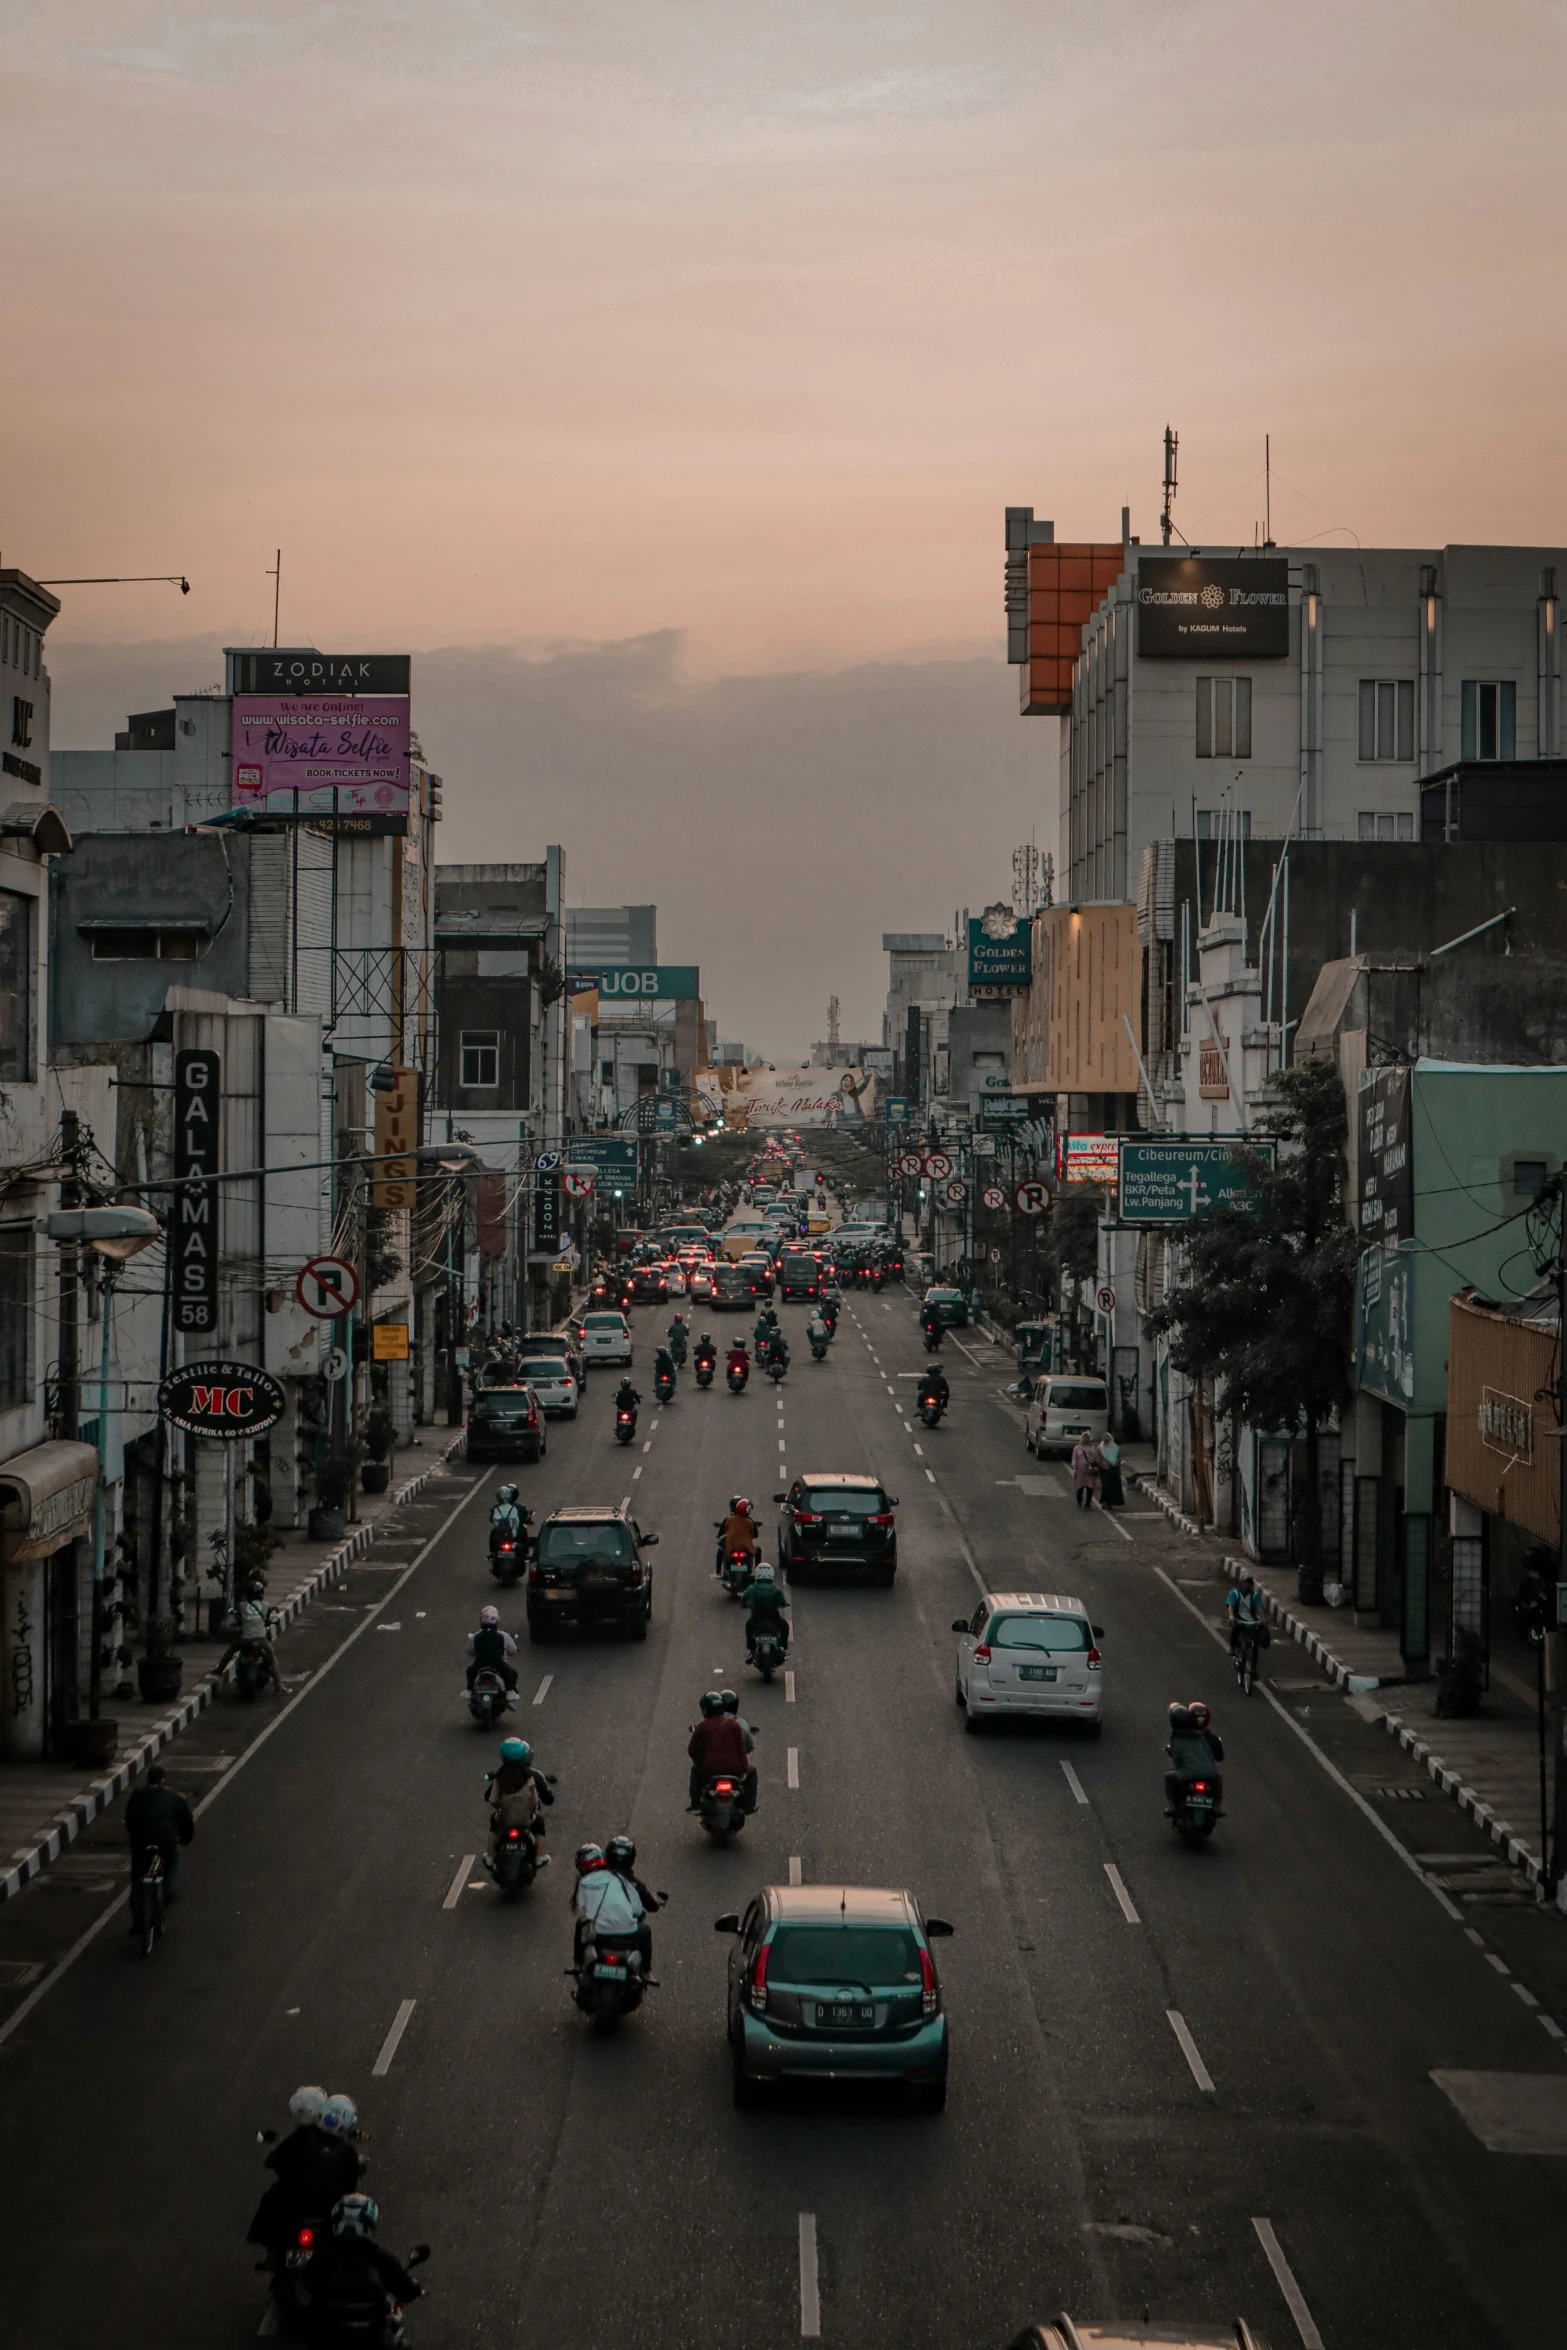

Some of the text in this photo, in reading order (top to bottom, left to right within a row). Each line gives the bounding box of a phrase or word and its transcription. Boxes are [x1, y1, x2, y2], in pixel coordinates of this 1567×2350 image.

[1138, 587, 1286, 605] GOLDEN FLOWER
[1178, 624, 1247, 634] by KAGUM Hotels
[273, 662, 370, 677] ZODIAK
[286, 678, 359, 686] HOTEL
[280, 702, 299, 712] We
[241, 713, 399, 728] www.wisata-selfie.com
[264, 729, 392, 762] Wisata Selfie
[306, 768, 399, 778] BOOK TICKETS NOW!
[343, 820, 372, 831] 7468
[973, 944, 1026, 958] GOLDEN
[973, 961, 1026, 974] FLOWER
[601, 971, 659, 994] UOB
[974, 987, 1023, 995] HOTEL
[747, 1096, 845, 1118] Tarik Malaka
[537, 1151, 559, 1171] 69
[1125, 1171, 1177, 1184] Tegallega
[1125, 1185, 1176, 1196] BKR/Peta
[1124, 1197, 1183, 1209] Lw.Panjang
[180, 1304, 209, 1325] 58
[163, 1364, 279, 1397] Textile & Tailor
[187, 1385, 254, 1418] MC
[173, 1415, 191, 1431] ASIA
[191, 1425, 223, 1437] AFRIKA
[224, 1429, 237, 1437] 60
